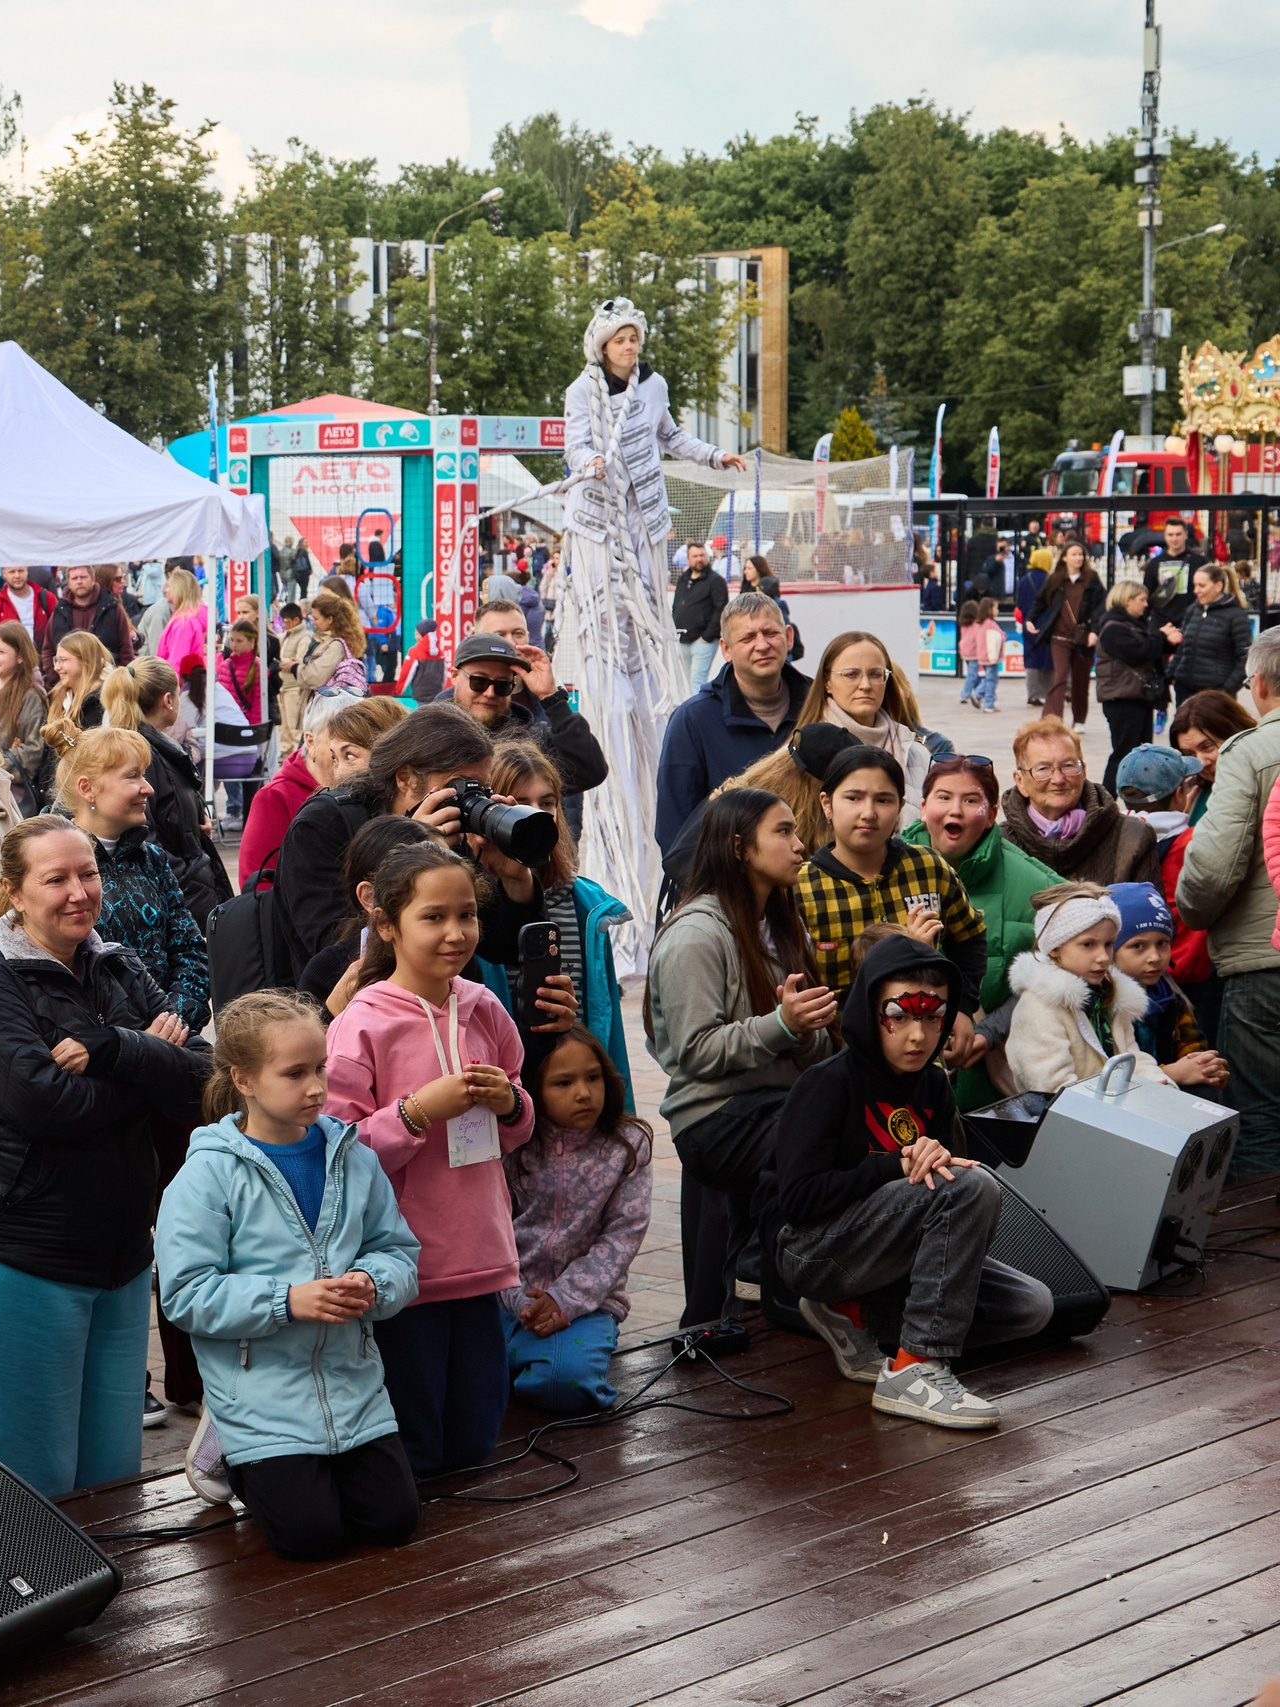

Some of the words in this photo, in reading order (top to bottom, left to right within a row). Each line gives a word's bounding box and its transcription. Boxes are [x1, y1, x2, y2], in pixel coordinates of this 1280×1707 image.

[324, 426, 355, 438] ЛЕТО
[545, 424, 566, 435] ЛЕТ
[323, 438, 329, 446] В
[330, 437, 355, 446] МОСКВЕ
[294, 461, 391, 482] ЛЕТО
[292, 486, 305, 495] В
[312, 484, 395, 495] МОСКВЕ
[440, 500, 453, 592] МОСКВЕ
[463, 500, 475, 593] МОСКВЕ
[463, 600, 474, 614] В
